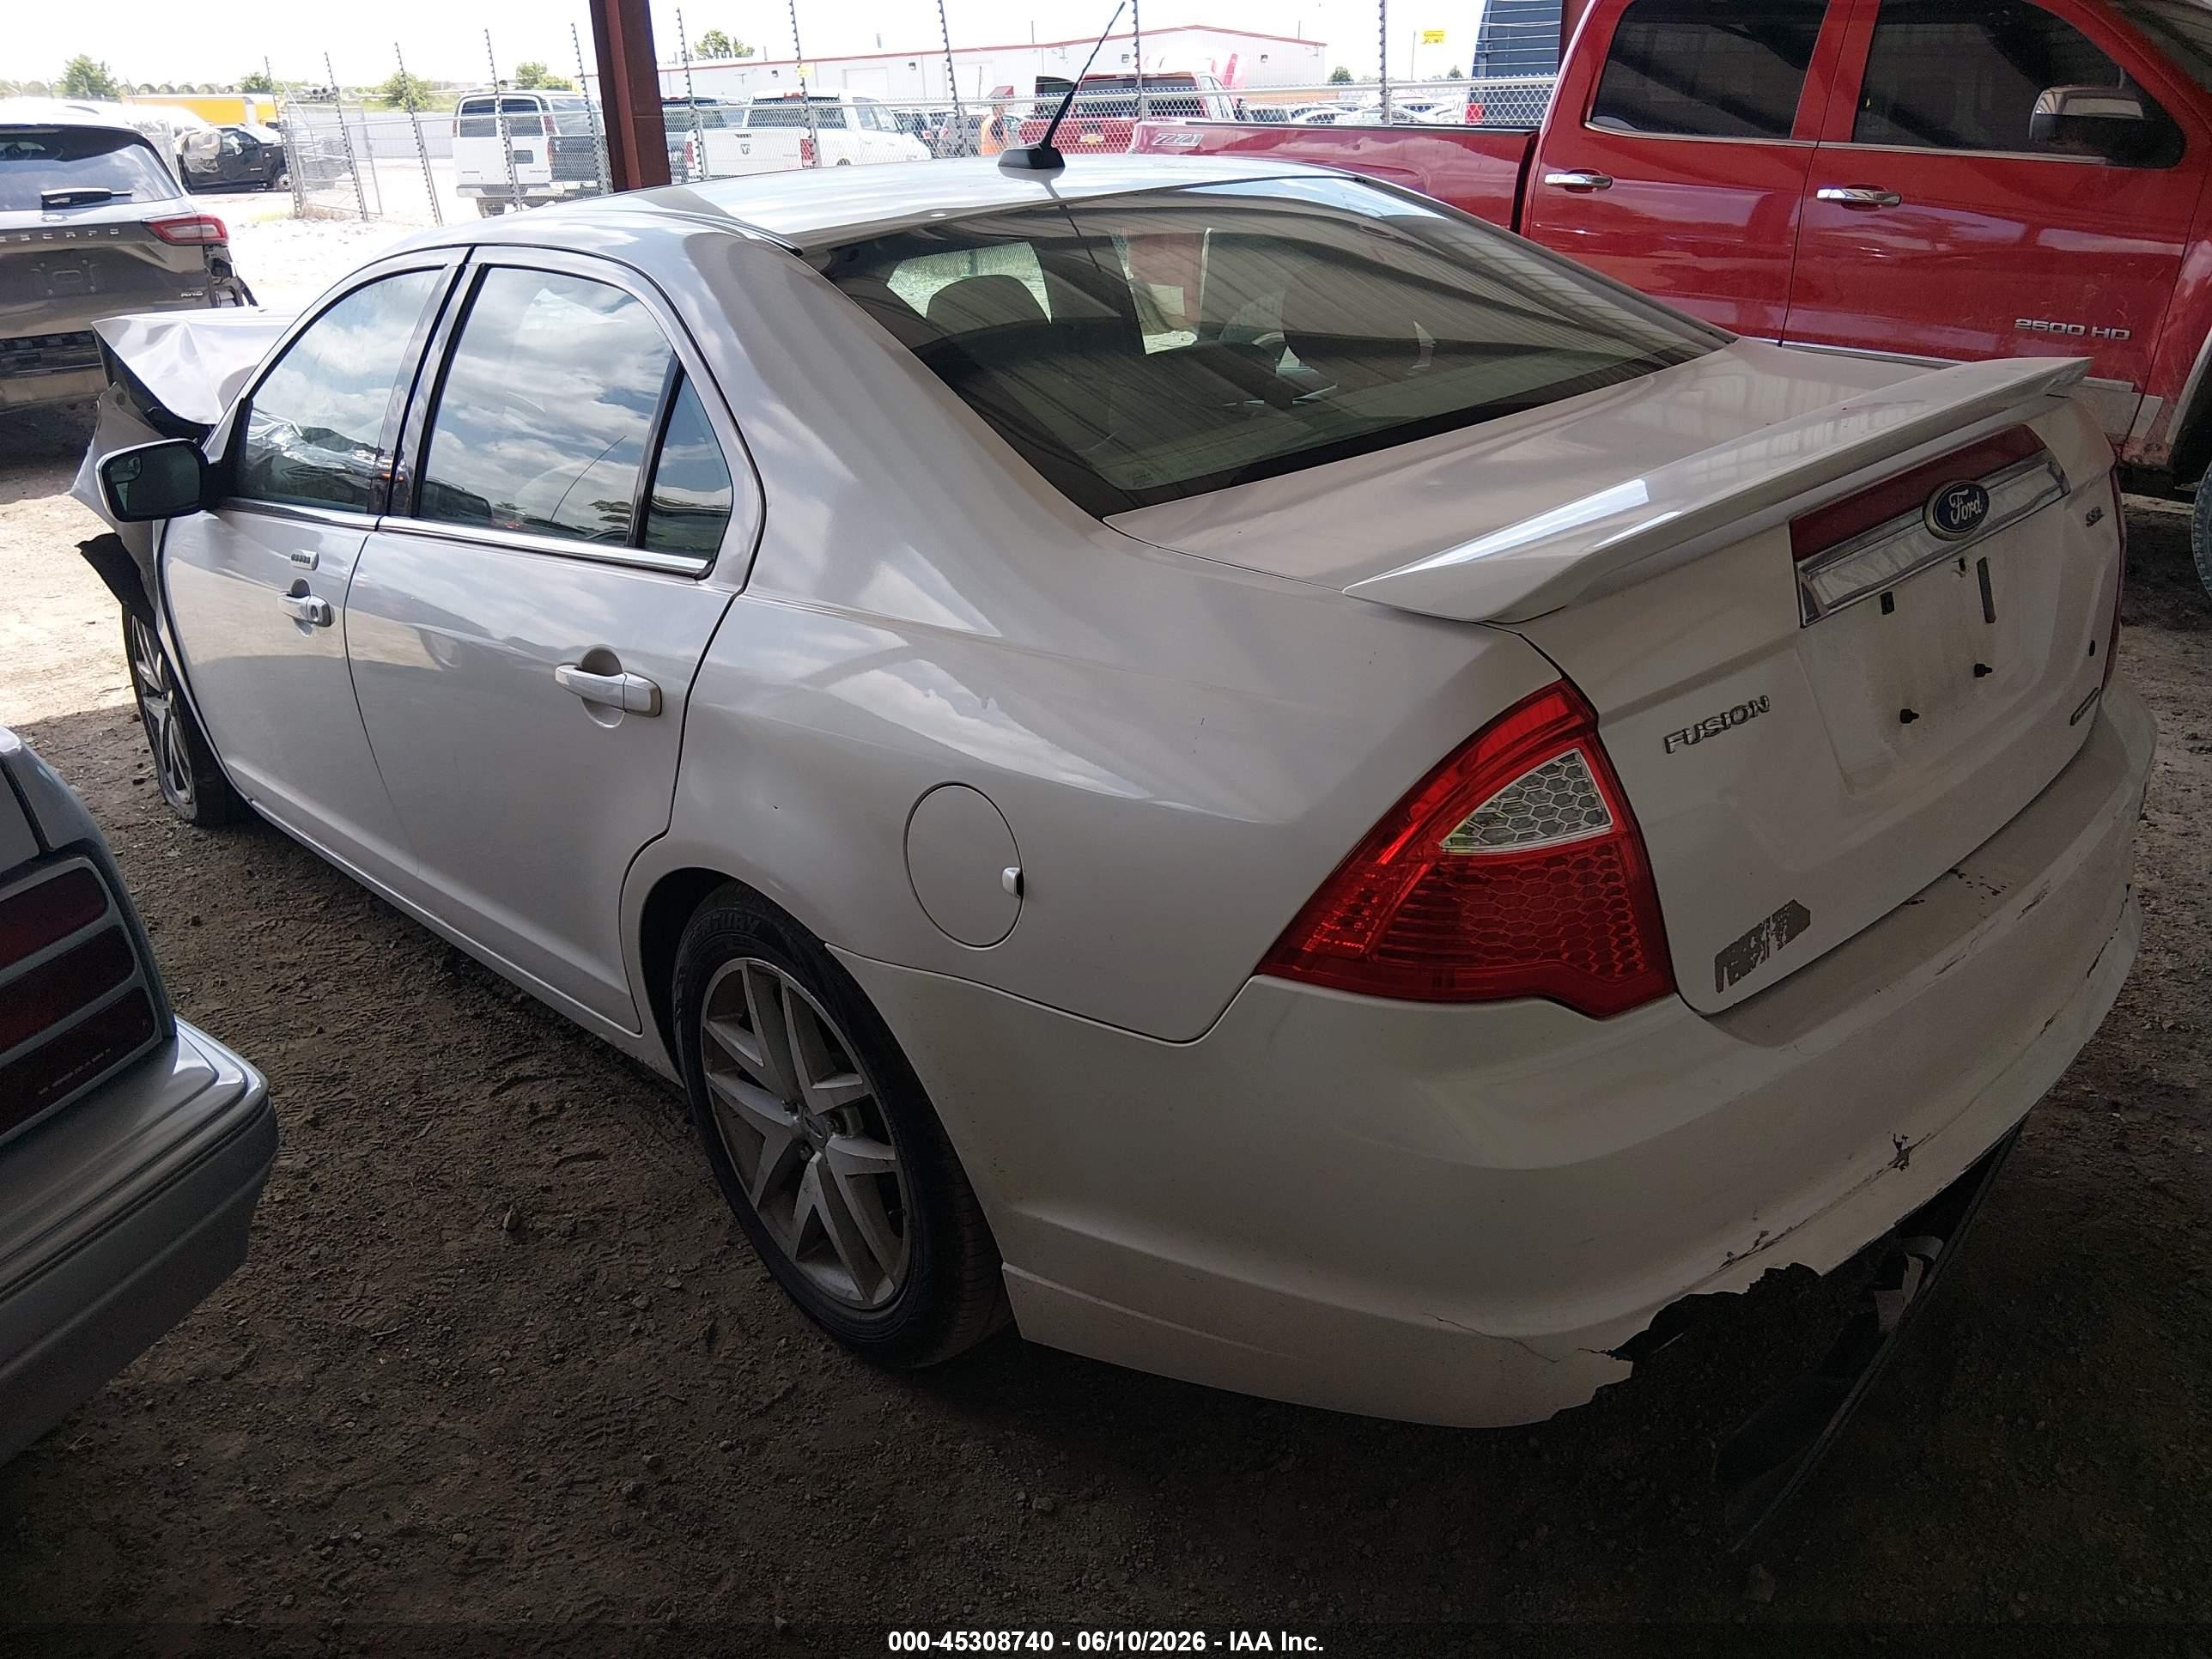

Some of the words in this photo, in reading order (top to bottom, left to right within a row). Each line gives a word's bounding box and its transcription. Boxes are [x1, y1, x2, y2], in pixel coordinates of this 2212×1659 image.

[1152, 132, 1204, 146] Z71
[2014, 318, 2085, 336] 2500
[2091, 326, 2130, 340] HD
[1948, 489, 1981, 525] Ford
[1664, 694, 1770, 754] FUSION
